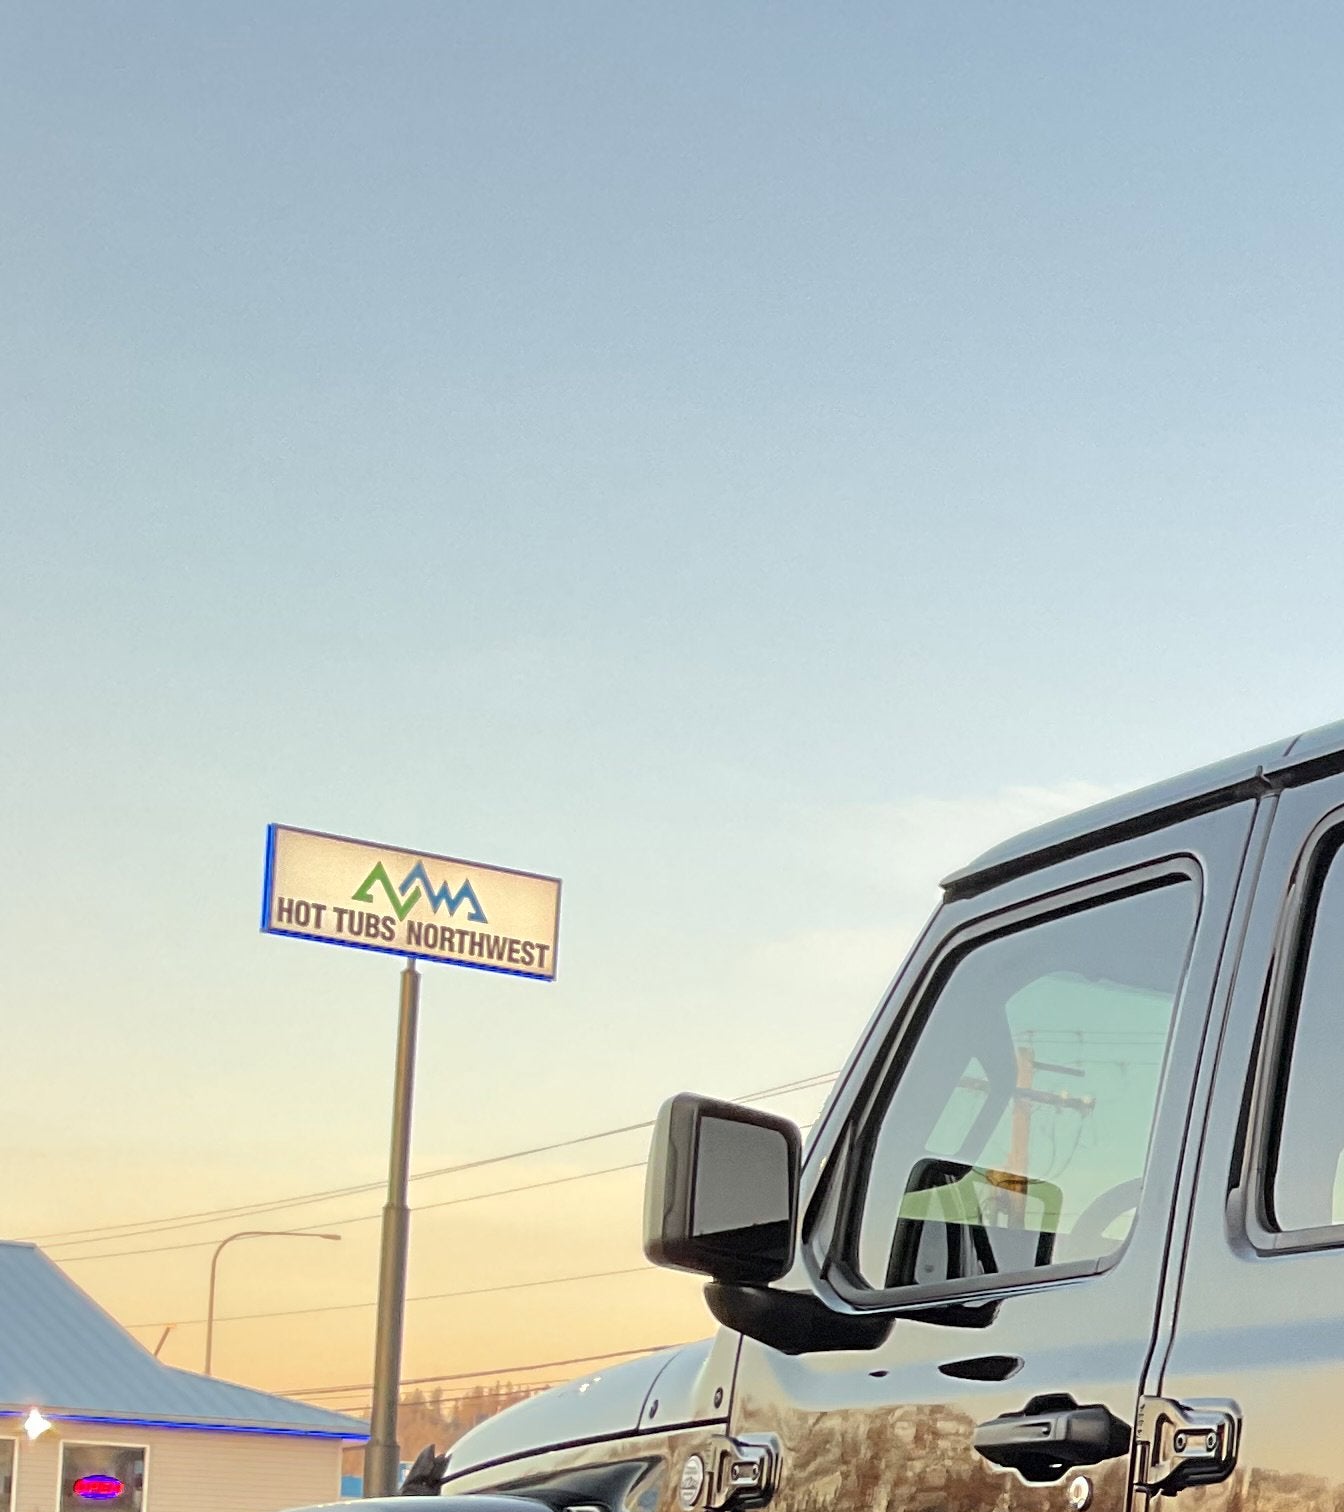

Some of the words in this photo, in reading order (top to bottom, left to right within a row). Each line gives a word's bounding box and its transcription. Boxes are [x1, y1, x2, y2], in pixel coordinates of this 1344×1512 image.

[276, 896, 327, 929] HOT
[333, 906, 397, 942] TUBS
[406, 919, 550, 968] NORTHWEST
